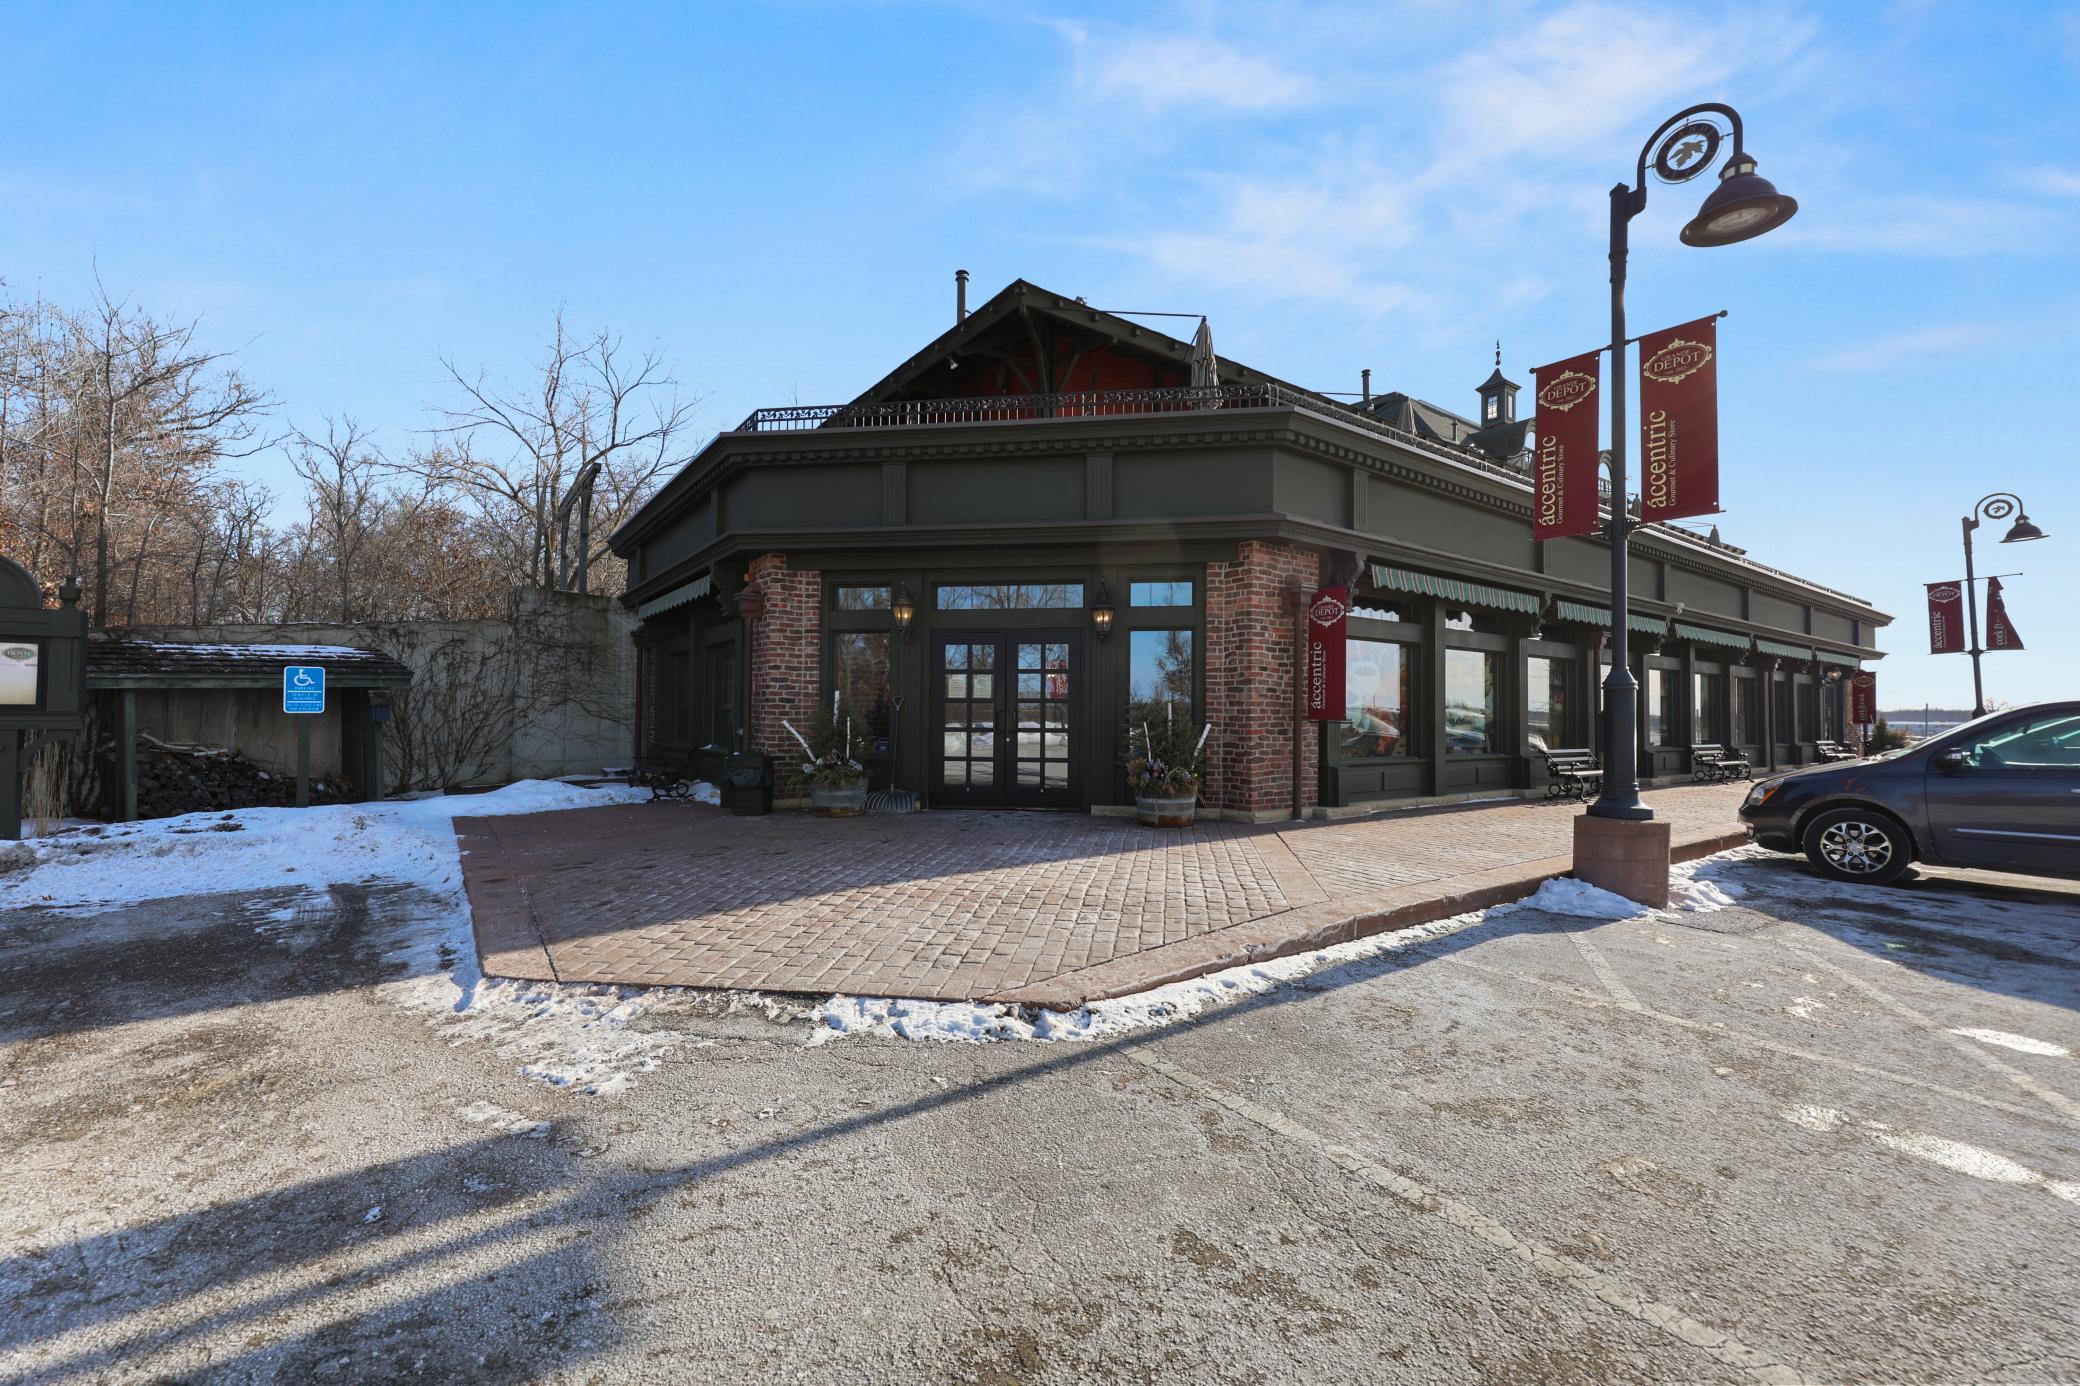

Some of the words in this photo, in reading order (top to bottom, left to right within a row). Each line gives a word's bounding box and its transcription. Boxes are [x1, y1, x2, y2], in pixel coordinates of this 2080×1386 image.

[1653, 350, 1701, 372] DEPOT
[1547, 381, 1587, 401] DEPOT
[1643, 410, 1666, 508] áccentric
[1668, 439, 1678, 468] Culinary
[1537, 435, 1556, 525] áccentric
[1557, 462, 1566, 489] Culinary
[1315, 608, 1339, 616] DEPOT
